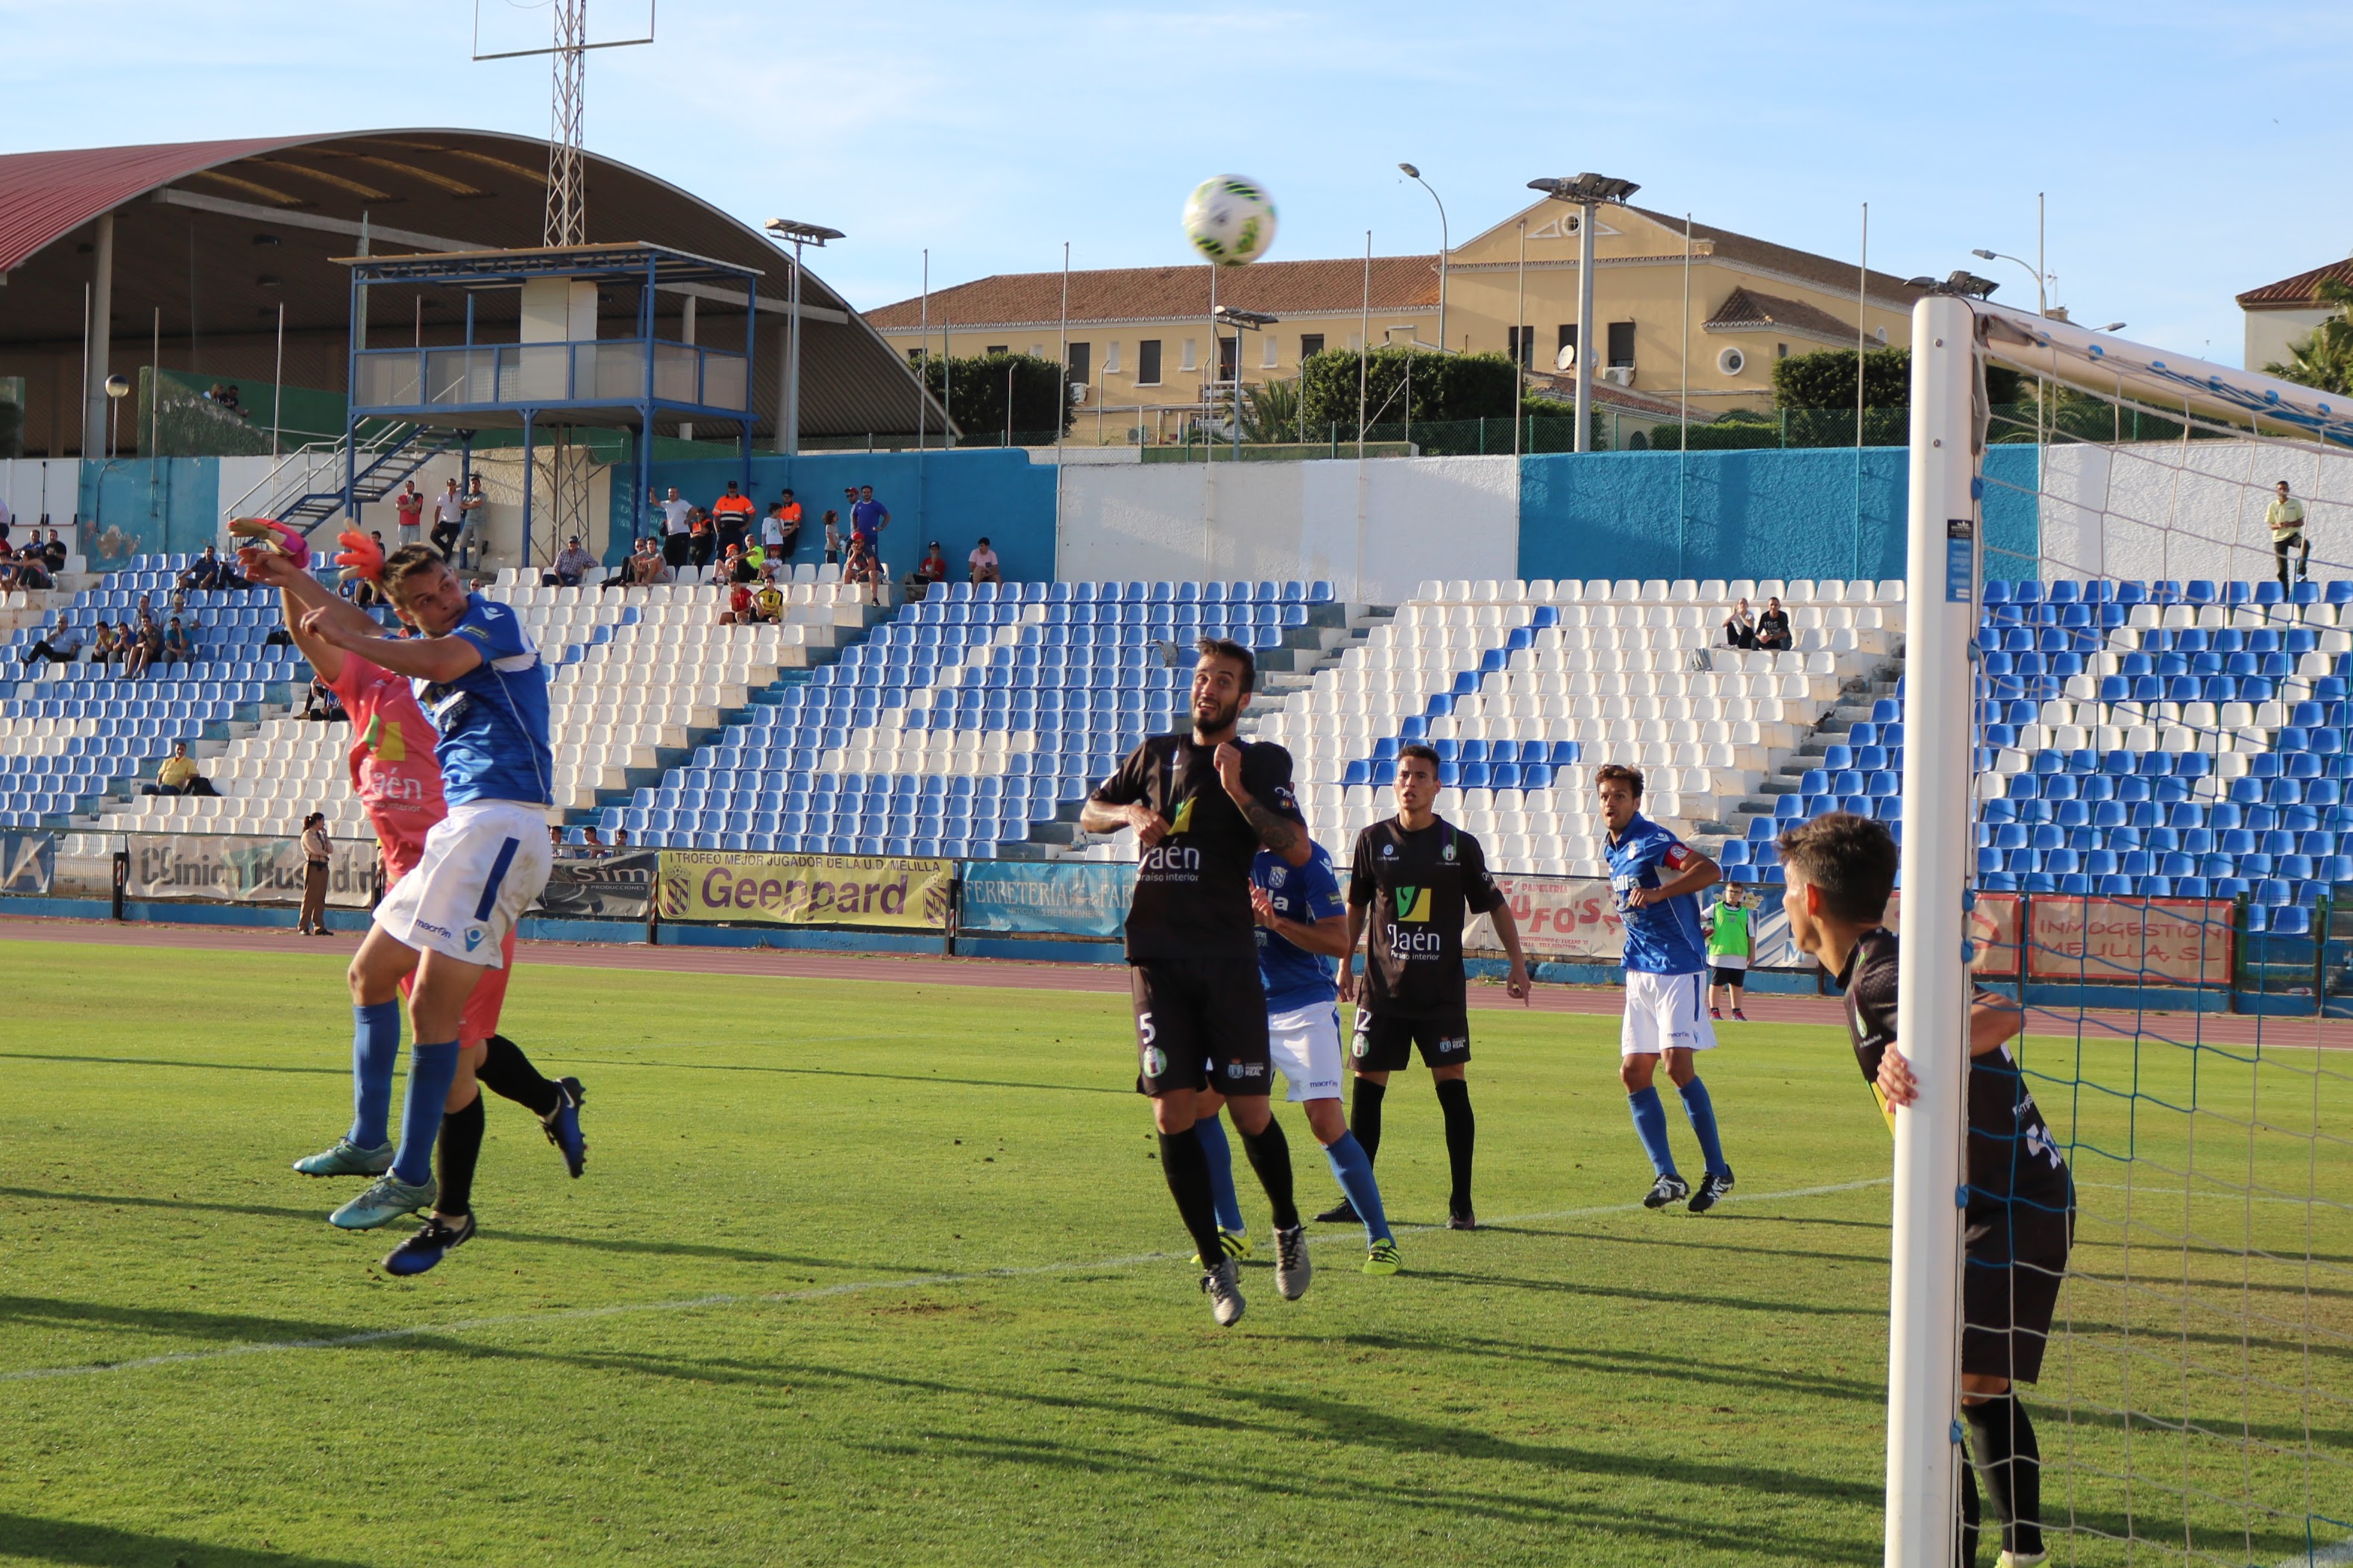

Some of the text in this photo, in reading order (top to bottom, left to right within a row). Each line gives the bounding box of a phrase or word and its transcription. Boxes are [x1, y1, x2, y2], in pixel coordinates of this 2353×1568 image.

[364, 767, 422, 800] aén
[670, 852, 940, 872] I TROFEO MEJOR JUGADOR DE LA U.D. MELILLA
[1147, 837, 1200, 870] aén
[572, 866, 649, 883] Sim
[1166, 873, 1199, 881] interior
[1612, 875, 1641, 892] elilla
[702, 867, 908, 922] Geeppard
[964, 875, 1067, 907] FERRETERÍA
[1047, 908, 1058, 916] DE
[415, 918, 451, 939] macron
[1387, 924, 1440, 951] Jaén
[2178, 947, 2220, 961] SL
[1140, 1012, 1156, 1045] 5
[1354, 1007, 1372, 1031] 12
